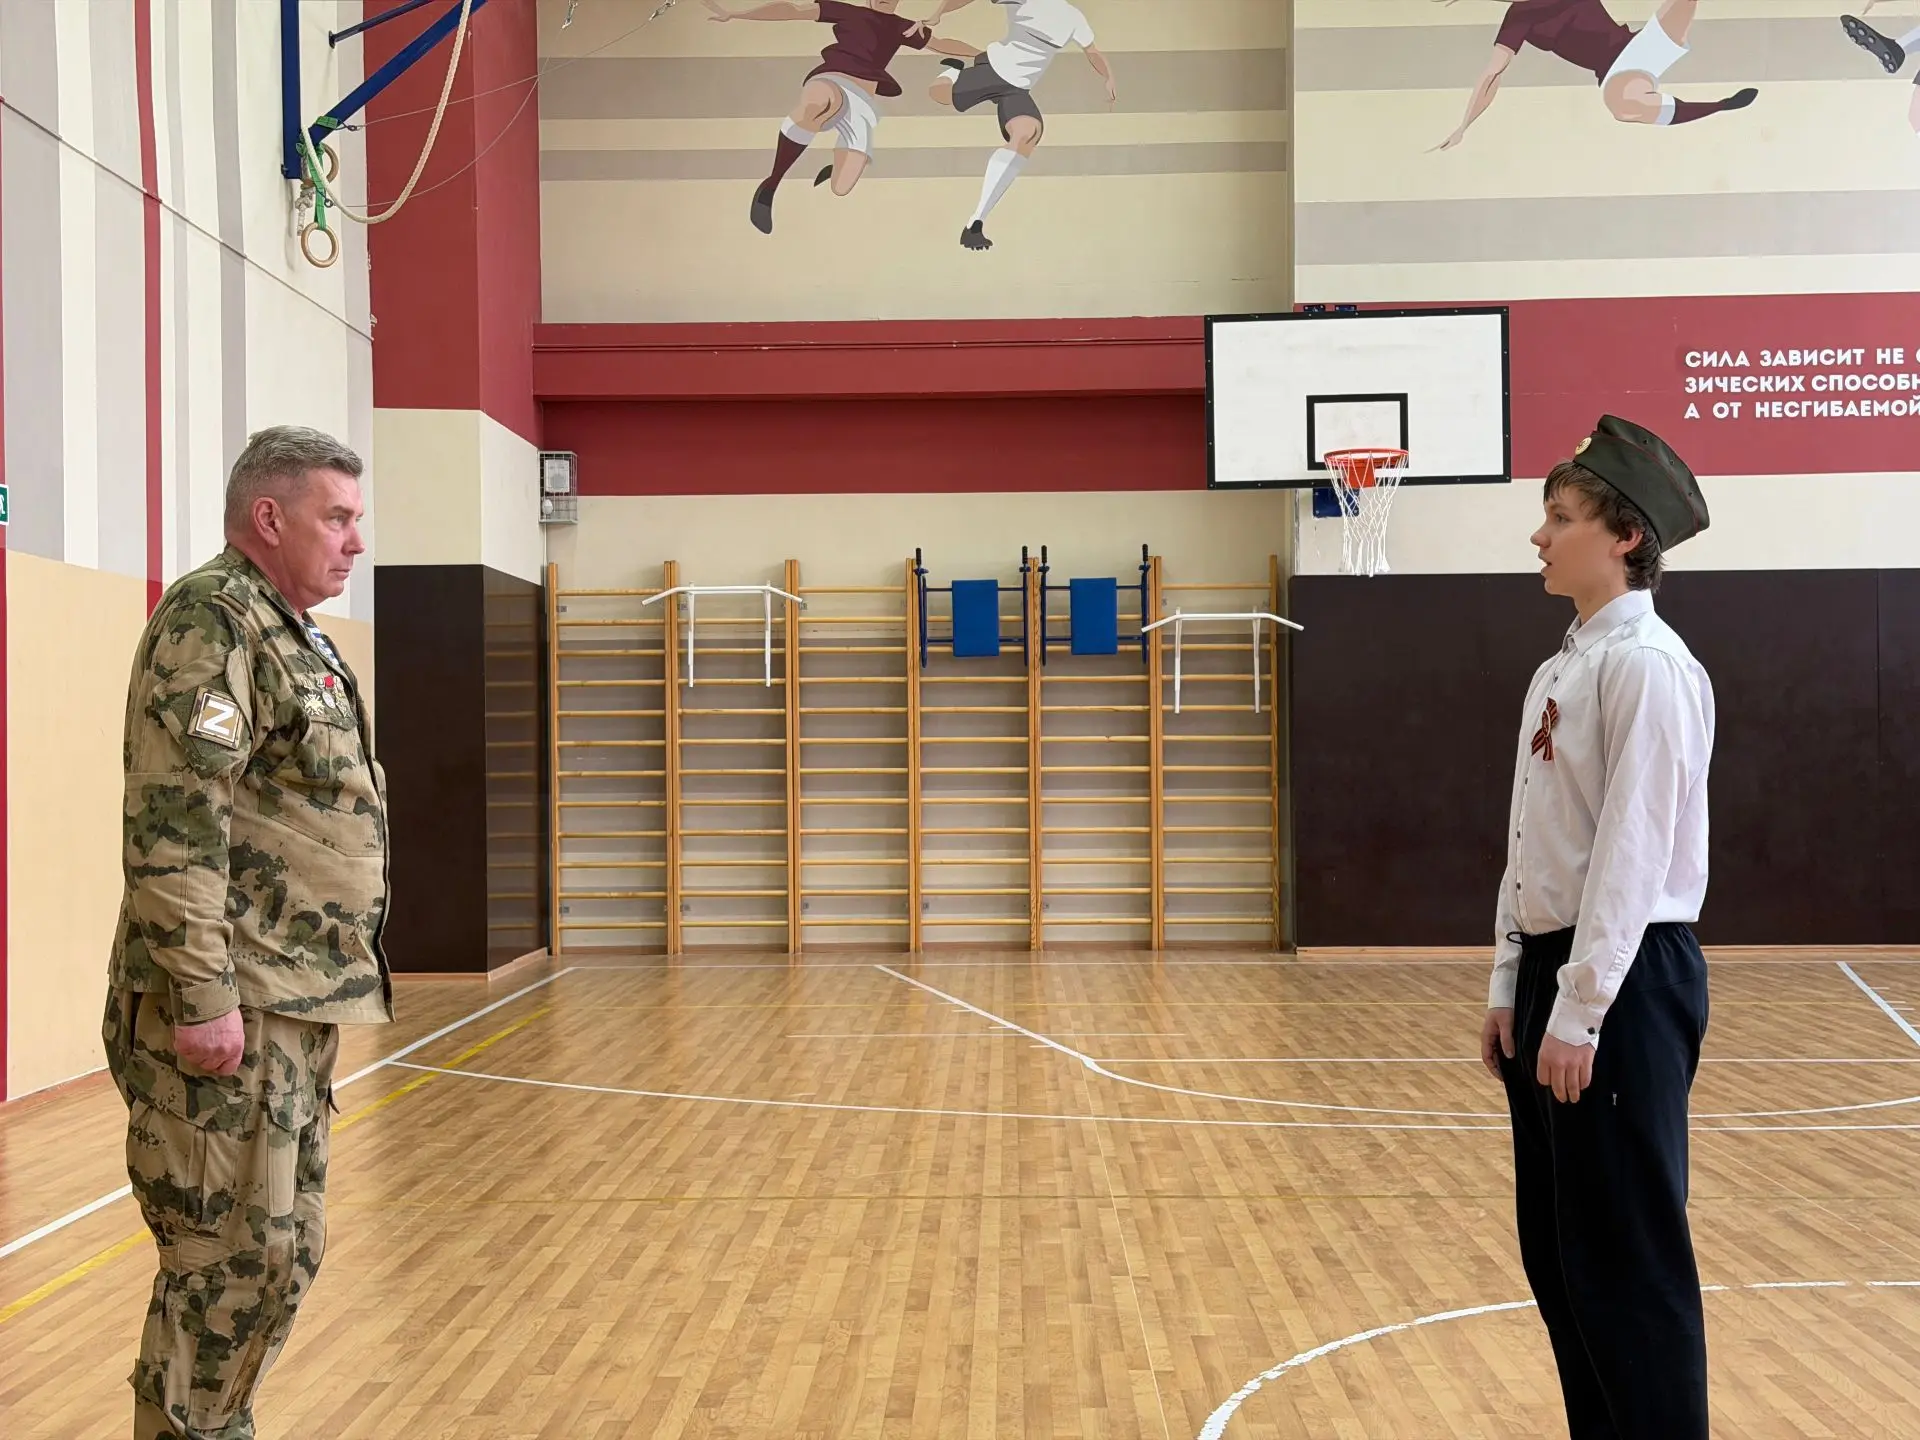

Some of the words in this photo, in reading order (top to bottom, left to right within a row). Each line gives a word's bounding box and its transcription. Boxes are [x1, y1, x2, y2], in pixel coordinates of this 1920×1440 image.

[1685, 351, 1750, 367] СИЛА
[1760, 349, 1865, 366] ЗАВИСИТ
[1876, 348, 1904, 364] НЕ
[1685, 376, 1805, 393] ЗИЧЕСКИХ
[1684, 403, 1700, 419] А
[1713, 402, 1742, 418] ОТ
[1755, 395, 1920, 418] НЕСГИБАЕМОЙ
[203, 699, 235, 735] Z
